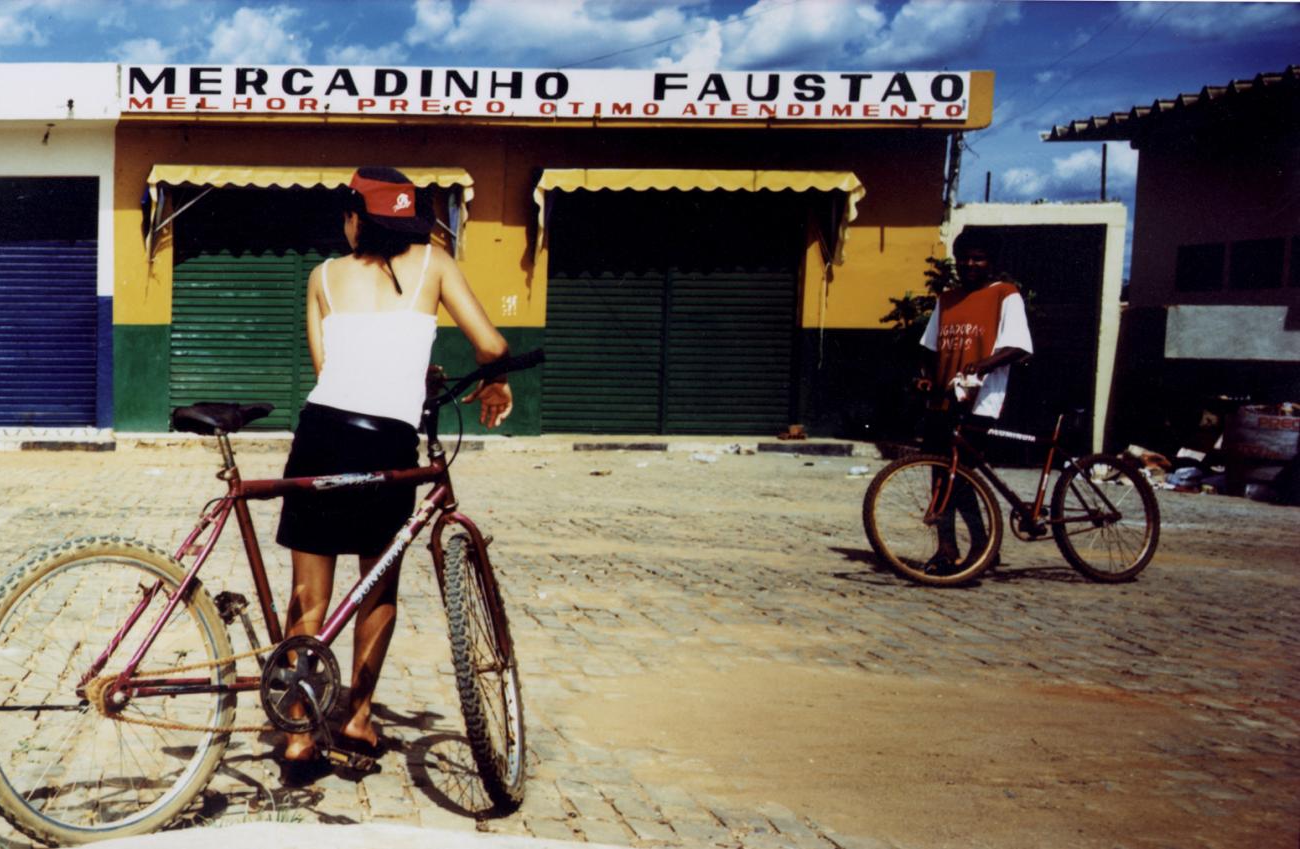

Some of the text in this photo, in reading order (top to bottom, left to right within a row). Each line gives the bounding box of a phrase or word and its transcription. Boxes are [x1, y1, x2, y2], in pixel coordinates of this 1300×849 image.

[129, 67, 569, 100] MERCADINHO
[129, 97, 319, 111] MELHOR
[681, 102, 963, 119] ATENDIMENTO
